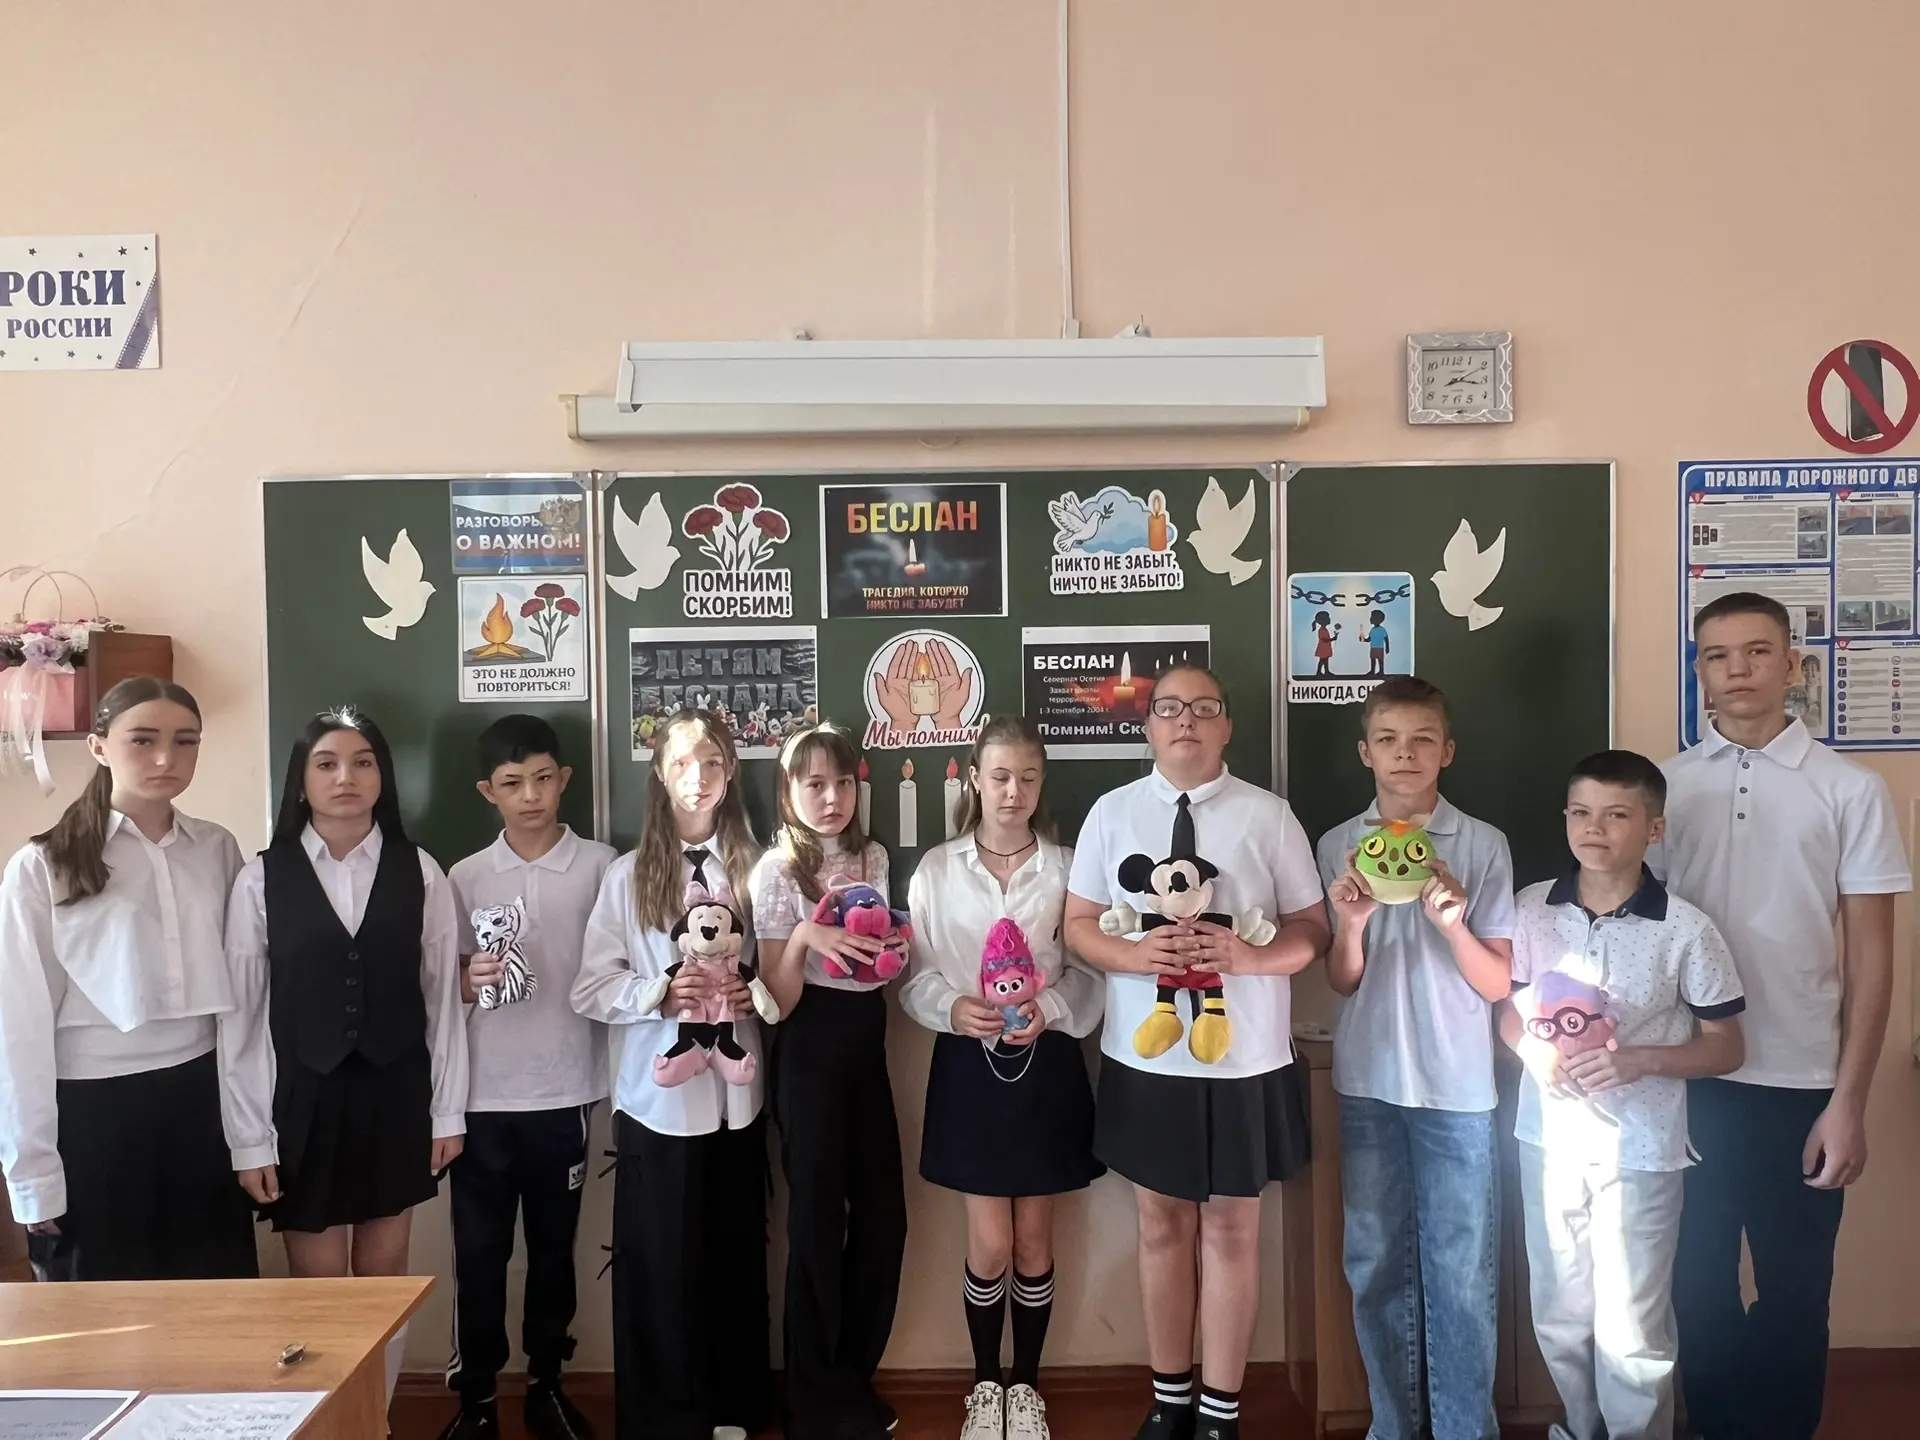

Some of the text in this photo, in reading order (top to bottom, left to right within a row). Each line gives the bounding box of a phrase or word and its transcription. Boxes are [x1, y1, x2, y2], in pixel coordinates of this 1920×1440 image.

[7, 317, 112, 339] РОССИИ
[1427, 361, 1438, 371] 10
[1441, 357, 1450, 366] 11
[1452, 356, 1463, 366] 12
[1467, 356, 1472, 366] 1
[1480, 361, 1488, 371] 2
[1426, 391, 1435, 401] 8
[1442, 394, 1449, 404] 7
[1453, 394, 1462, 404] 6
[1466, 394, 1474, 404] 5
[1704, 470, 1782, 488] ПРАВИЛА
[1785, 467, 1889, 488] ДОРОЖНОГО
[847, 500, 977, 534] БЕСЛАН
[456, 533, 580, 551] О ВАЖНОМ!
[1055, 553, 1177, 572] НИКТО НЕ ЗАБЫТ,
[685, 572, 790, 592] ПОМНИМ!
[1053, 572, 1181, 591] НИЧТО НЕ ЗАБЫТО!
[919, 585, 969, 598] КОТОРУЮ
[685, 596, 791, 615] СКОРБИМ!
[866, 598, 965, 610] НИКТО НЕ ЗАБУДЕТ
[655, 647, 782, 680] ДЕТЯМ
[1033, 654, 1115, 670] БЕСЛАН
[472, 667, 576, 679] ЭТО НЕ ДОЛЖНО
[477, 681, 571, 693] ПОВТОРИТЬСЯ!
[1292, 686, 1355, 701] НИКОГДА
[864, 720, 901, 747] Мы
[1037, 722, 1114, 736] Помним!
